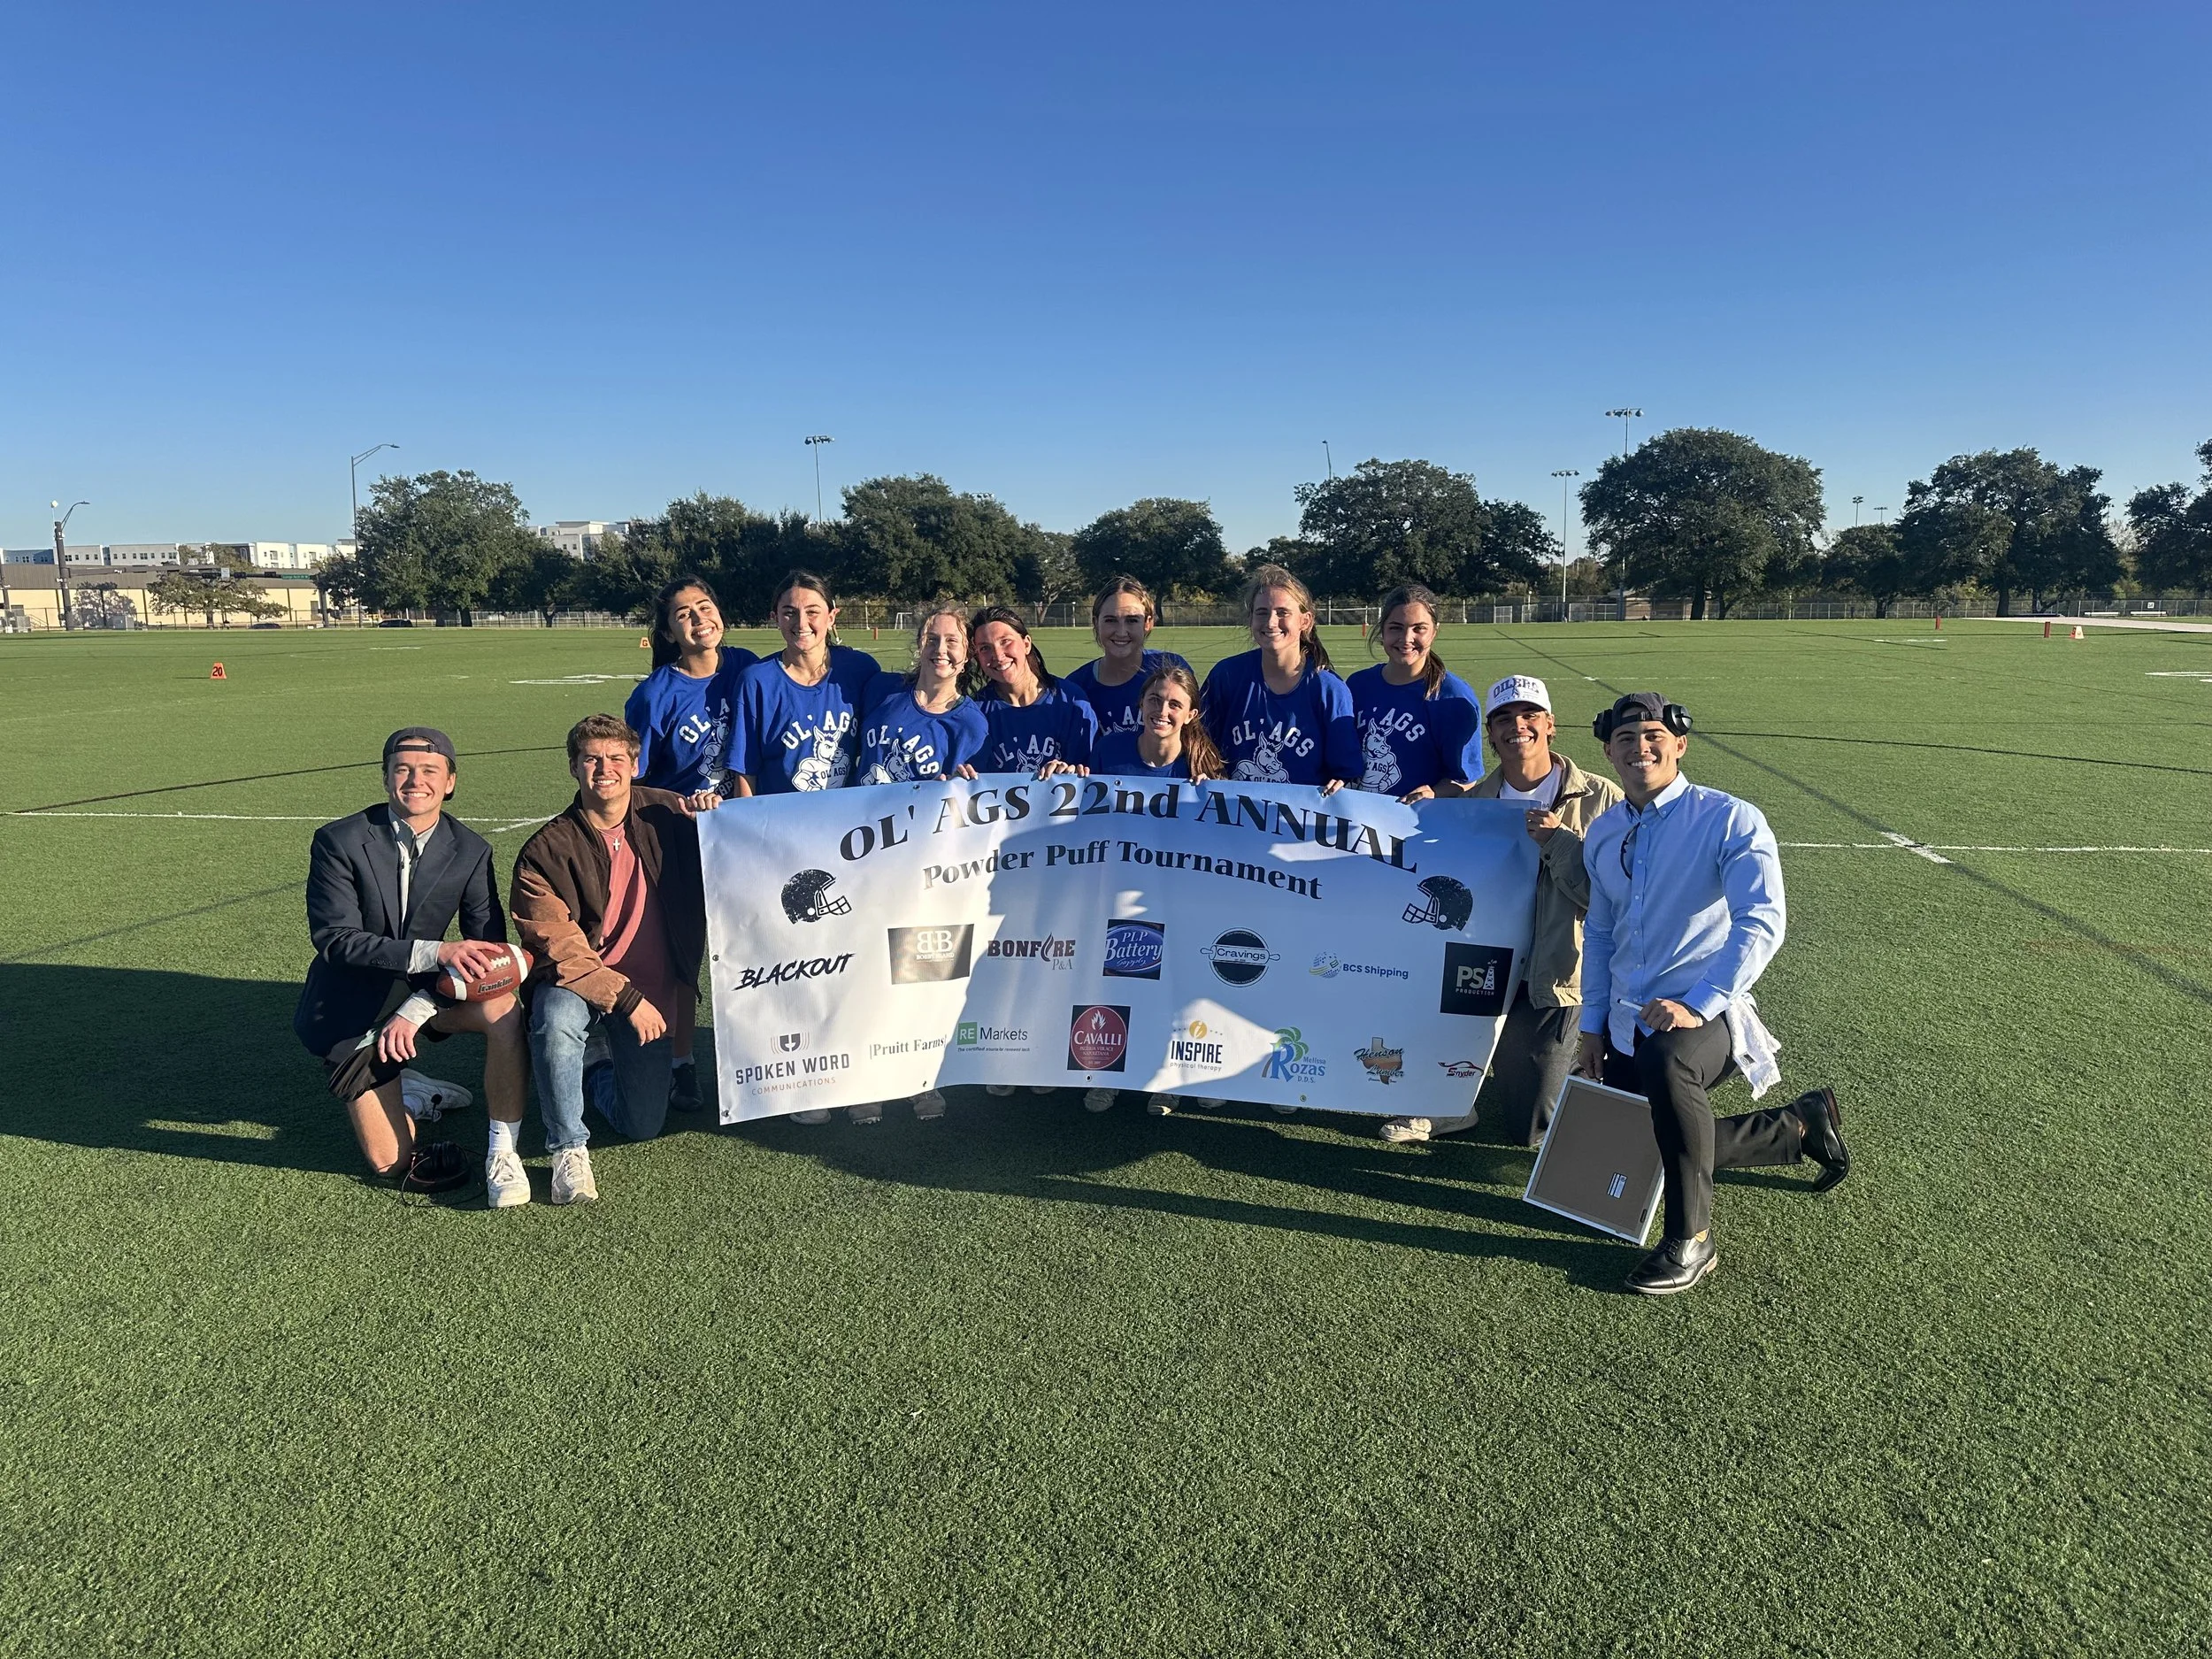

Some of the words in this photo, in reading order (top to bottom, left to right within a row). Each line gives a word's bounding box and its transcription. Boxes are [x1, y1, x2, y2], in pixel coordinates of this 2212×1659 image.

[212, 666, 223, 677] 20
[1494, 678, 1539, 698] OILERS
[781, 714, 812, 749] OL'
[823, 710, 857, 737] AGS
[1379, 708, 1425, 741] AGS
[1026, 734, 1062, 760] AGS
[1232, 718, 1264, 745] OL'
[1269, 721, 1314, 757] AGS
[867, 725, 902, 748] OL'
[902, 735, 939, 774] AGS
[833, 766, 847, 776] AGS
[1371, 763, 1387, 772] AGS
[840, 804, 915, 861] OL'
[933, 785, 1031, 834] AGS
[1048, 781, 1180, 818] 22nd
[1194, 791, 1417, 873] ANNUAL
[922, 849, 1034, 890] Powder
[1046, 840, 1110, 866] Puff
[1117, 841, 1322, 899] Tournament
[987, 933, 1076, 961] BONFIRE
[1122, 932, 1148, 942] PLP
[1104, 938, 1163, 962] Battery
[1217, 949, 1266, 961] Cravings
[731, 953, 856, 991] BLACKOUT
[1052, 958, 1072, 970] P&A
[1342, 964, 1363, 972] BCS
[1364, 965, 1409, 979] Shipping
[960, 1028, 974, 1040] RE
[979, 1027, 1028, 1041] Markets
[1074, 1031, 1122, 1046] CAVALLI
[1171, 1041, 1223, 1064] INSPIRE
[736, 1060, 795, 1085] SPOKEN
[803, 1053, 849, 1073] WORD
[1447, 1068, 1476, 1078] Snyder
[752, 1076, 836, 1095] COMMUNICATIONS
